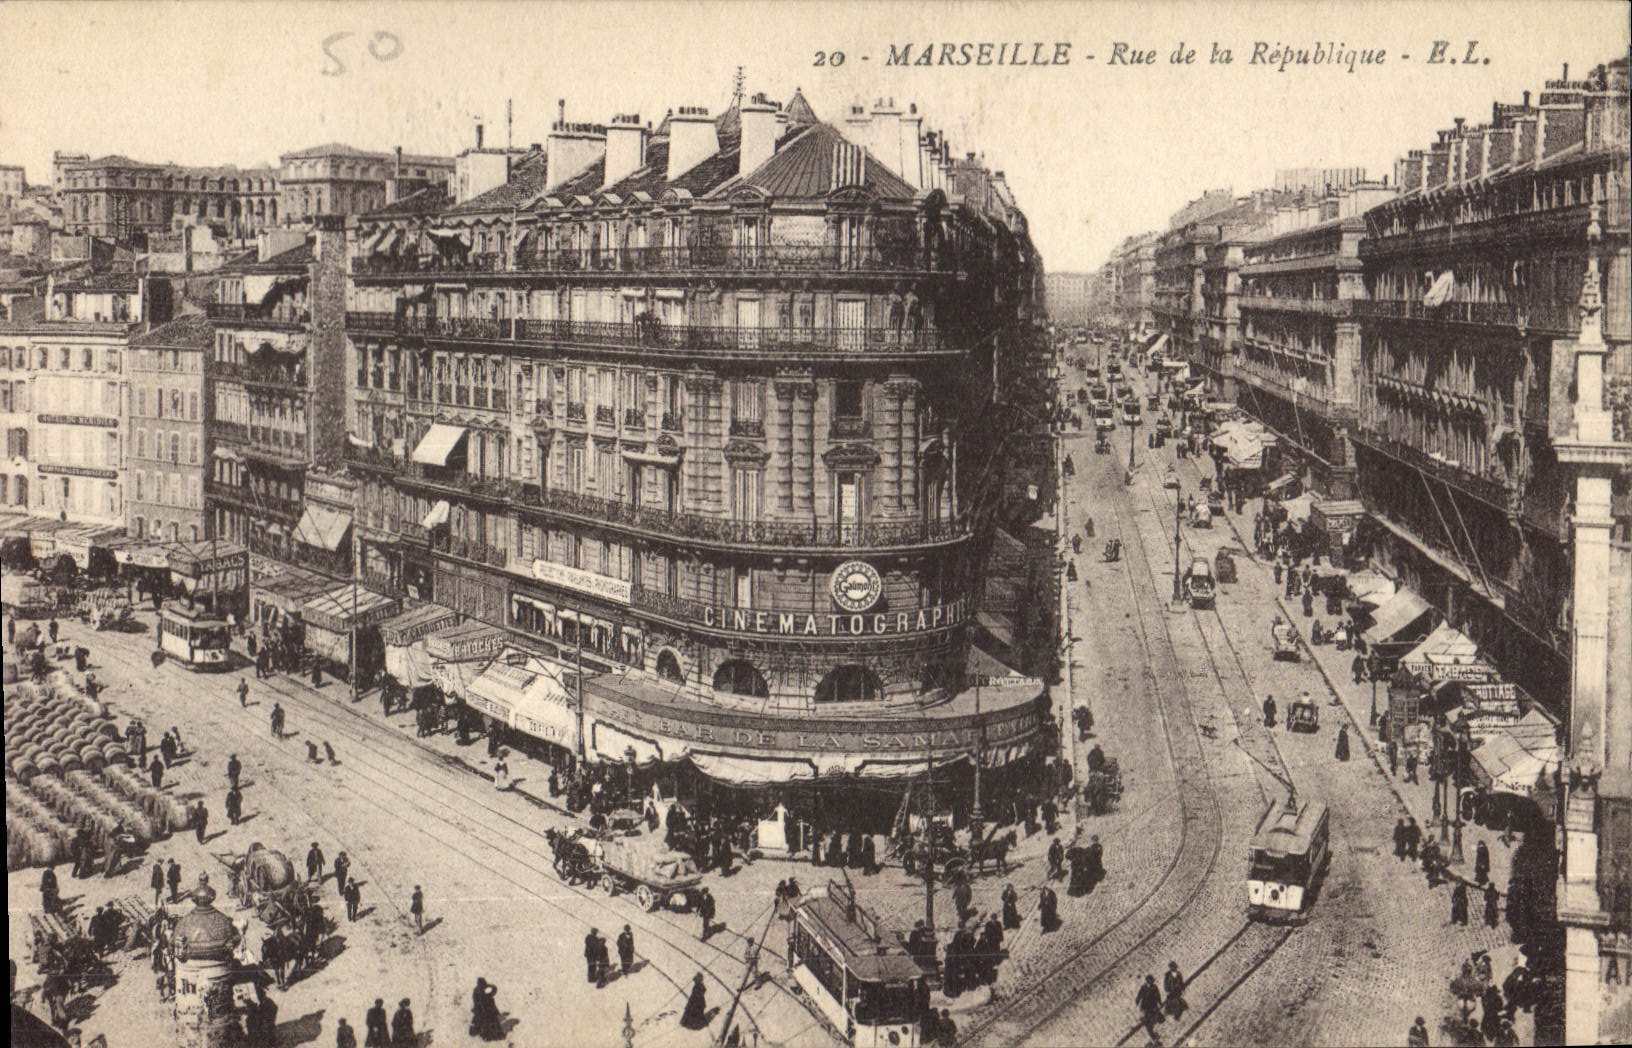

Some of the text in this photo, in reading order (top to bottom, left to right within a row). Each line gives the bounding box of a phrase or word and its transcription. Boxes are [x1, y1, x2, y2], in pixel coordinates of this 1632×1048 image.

[322, 31, 404, 76] 50
[660, 720, 714, 741] BAR
[735, 730, 775, 745] DE
[799, 734, 841, 748] LA
